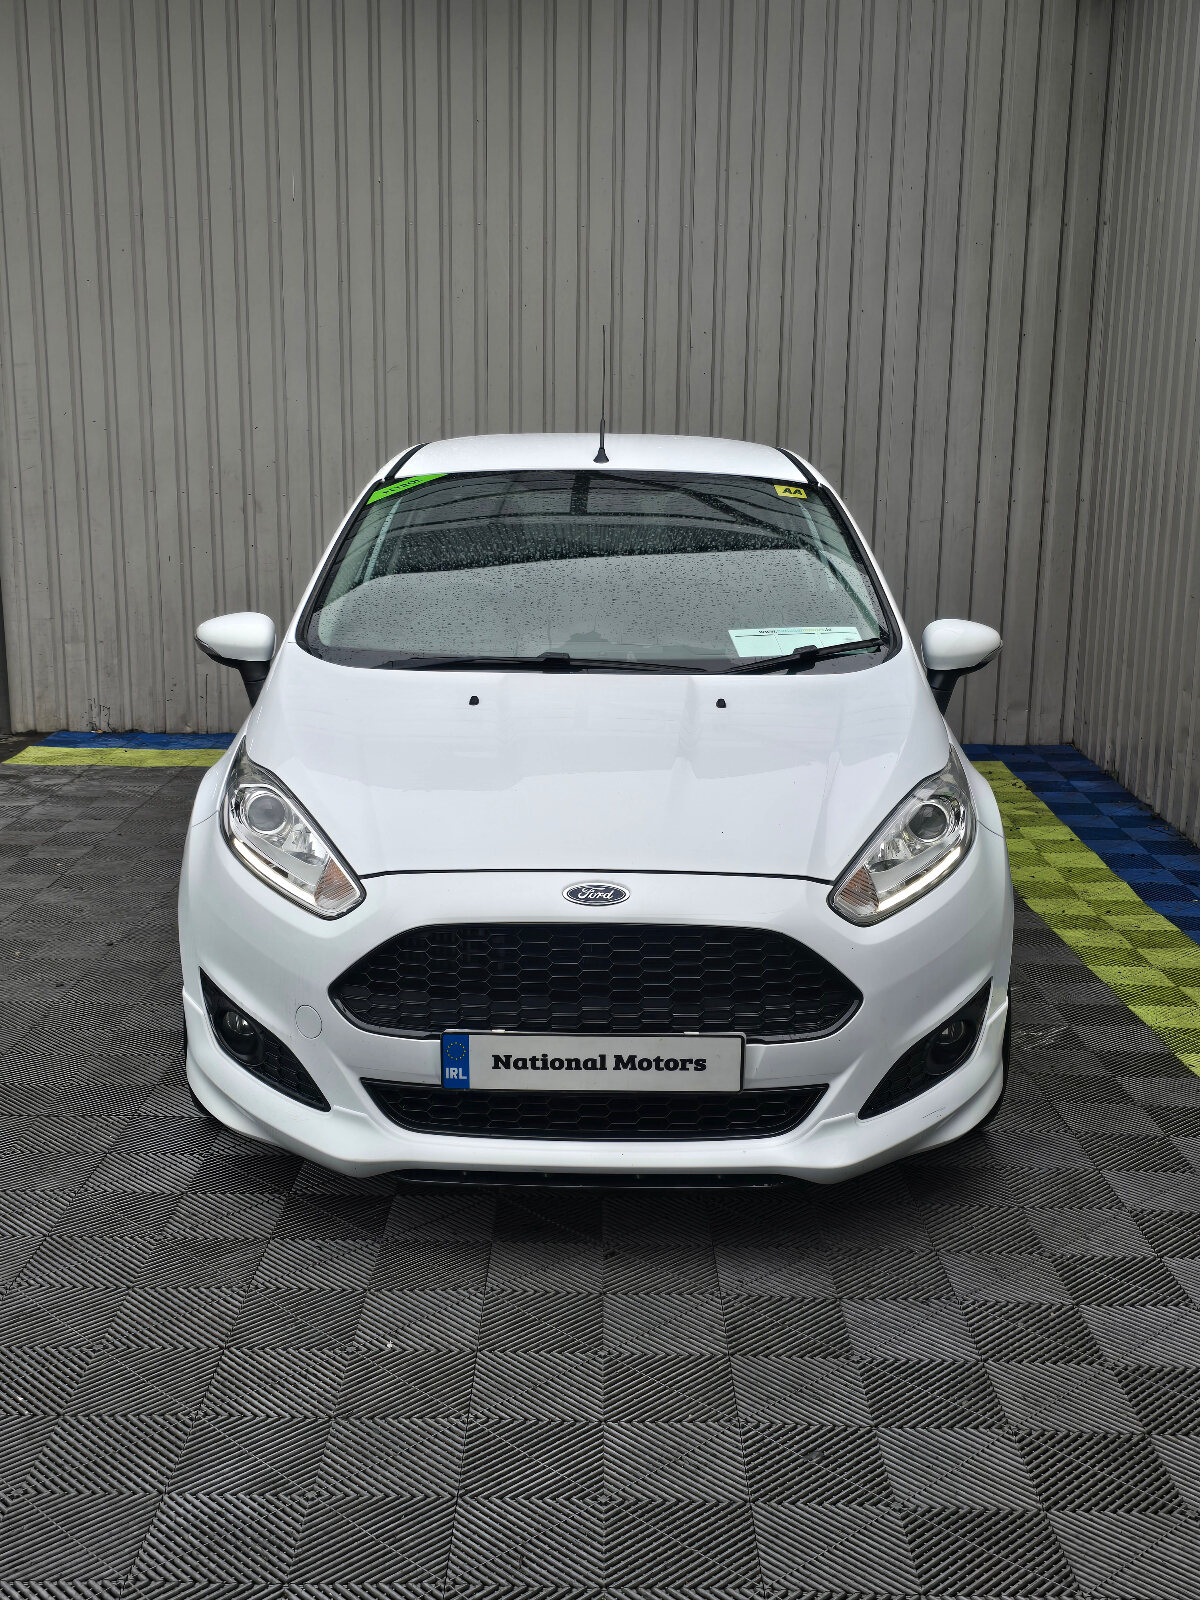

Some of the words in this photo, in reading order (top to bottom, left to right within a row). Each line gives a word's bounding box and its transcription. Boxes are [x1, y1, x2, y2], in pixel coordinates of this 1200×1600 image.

[782, 487, 803, 496] AA
[578, 887, 614, 899] Ford
[491, 1053, 608, 1072] National
[613, 1054, 707, 1072] Motors
[445, 1067, 468, 1080] IRL
